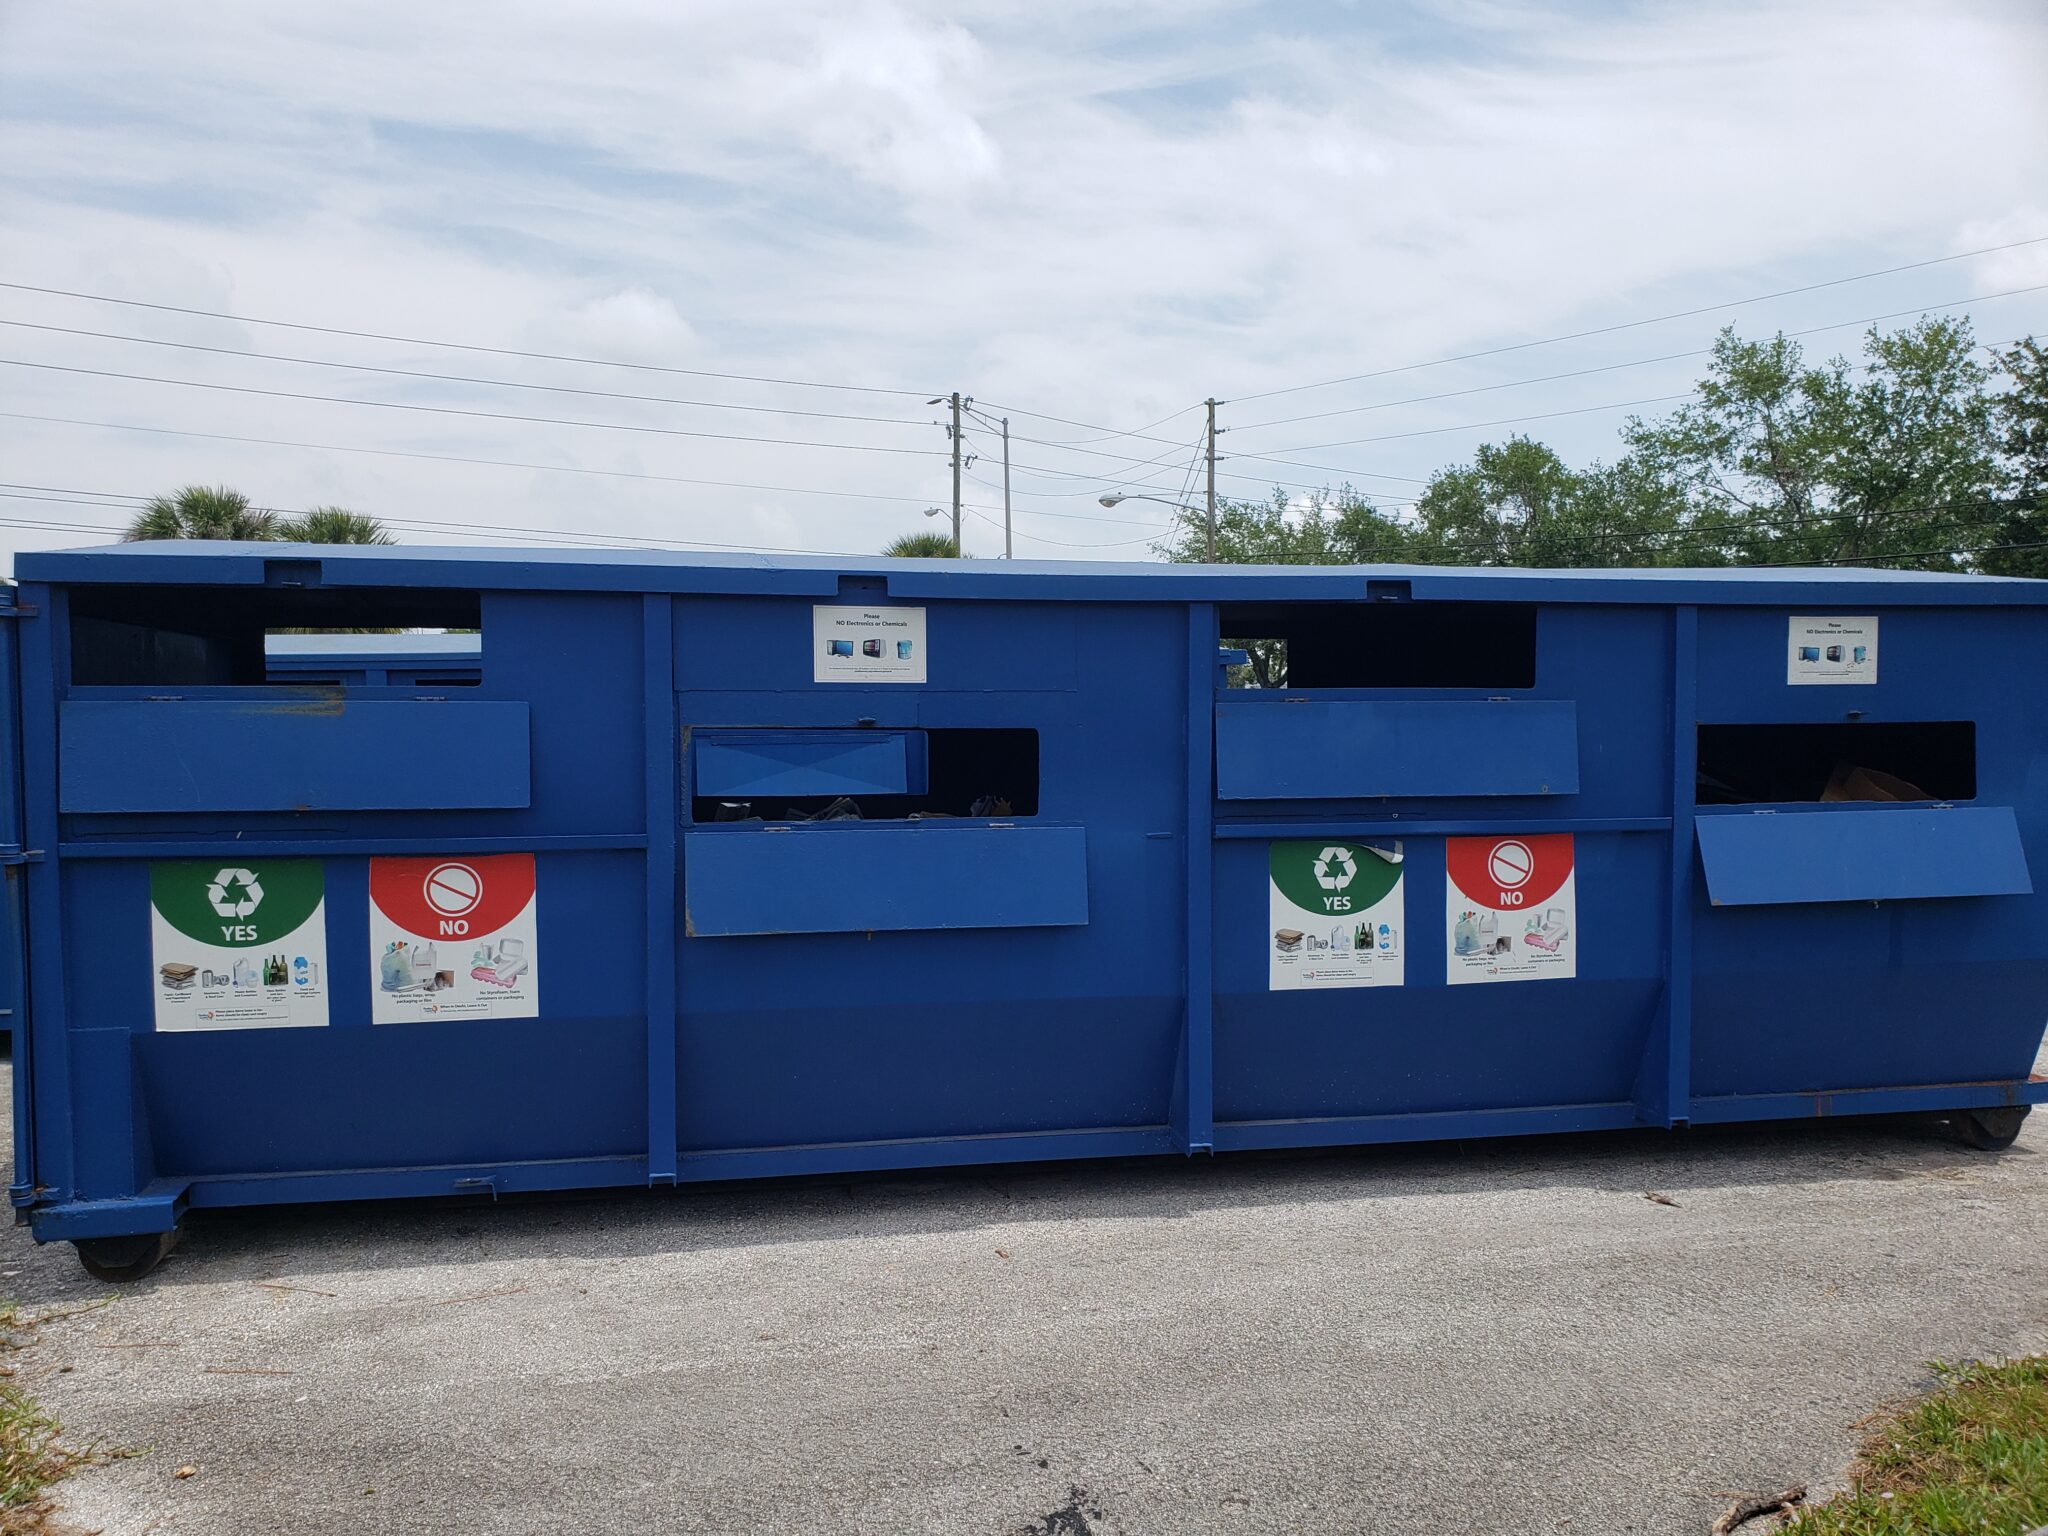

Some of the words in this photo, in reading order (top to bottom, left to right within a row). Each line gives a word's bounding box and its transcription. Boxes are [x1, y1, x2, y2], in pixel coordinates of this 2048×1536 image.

[1323, 896, 1351, 911] YES
[1500, 891, 1523, 905] NO
[221, 925, 258, 942] YES
[439, 920, 469, 936] NO
